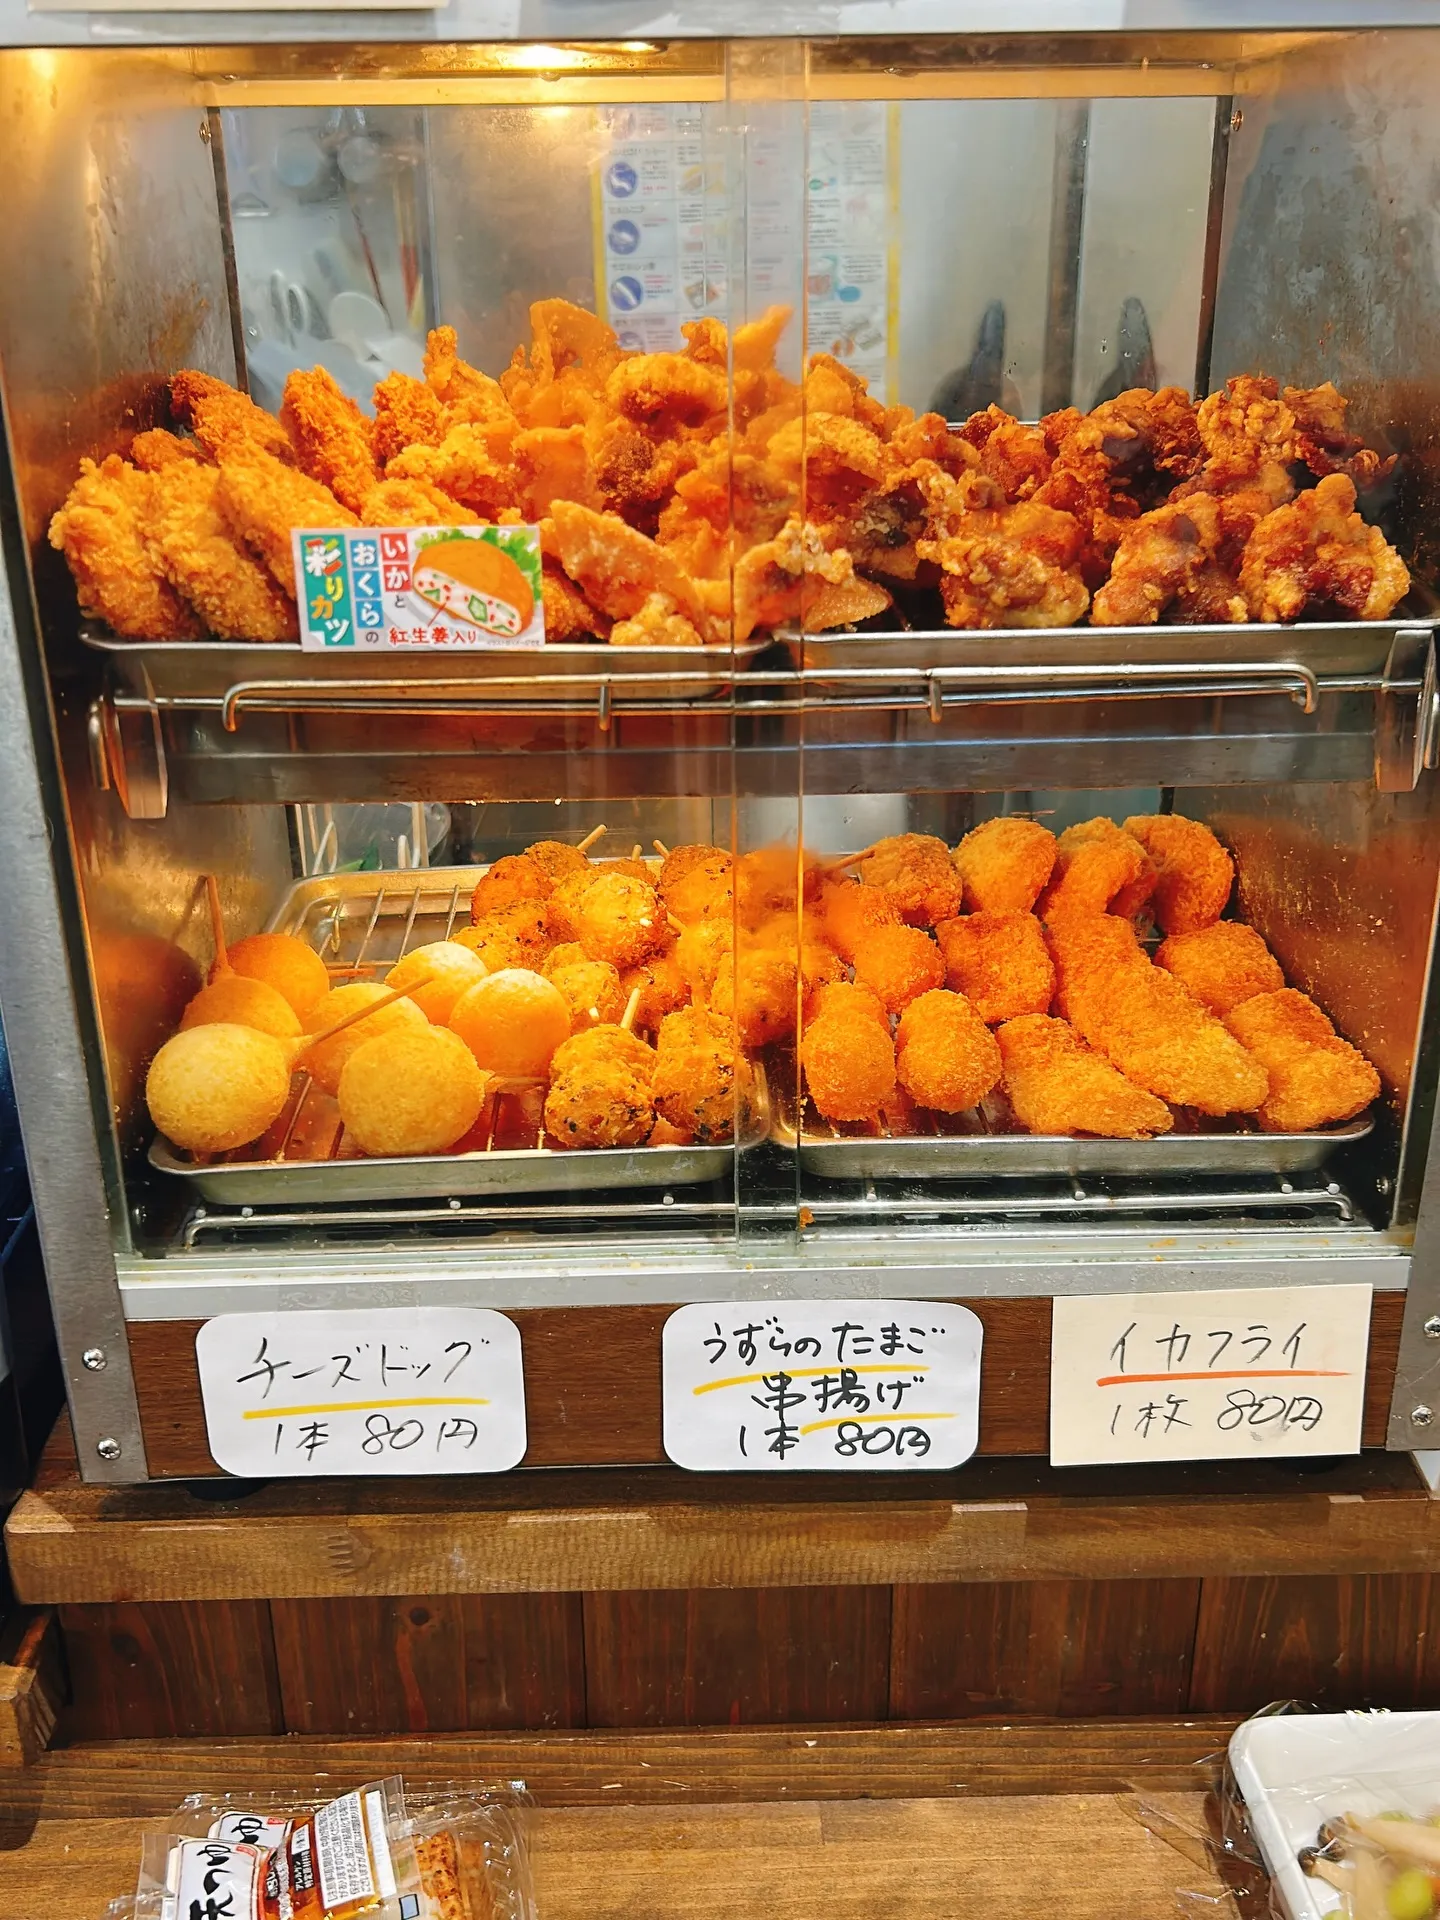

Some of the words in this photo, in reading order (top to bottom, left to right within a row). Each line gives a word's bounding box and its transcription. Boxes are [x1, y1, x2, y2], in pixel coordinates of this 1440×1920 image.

[303, 538, 350, 643] 彩りカツ
[389, 627, 478, 644] 紅生姜入り
[236, 1337, 491, 1399] チーズドッグ
[1110, 1322, 1307, 1373] イカフライ
[751, 1368, 925, 1420] 串揚げ
[1217, 1388, 1323, 1432] 80円
[361, 1413, 478, 1455] 80円
[834, 1421, 932, 1457] 80円
